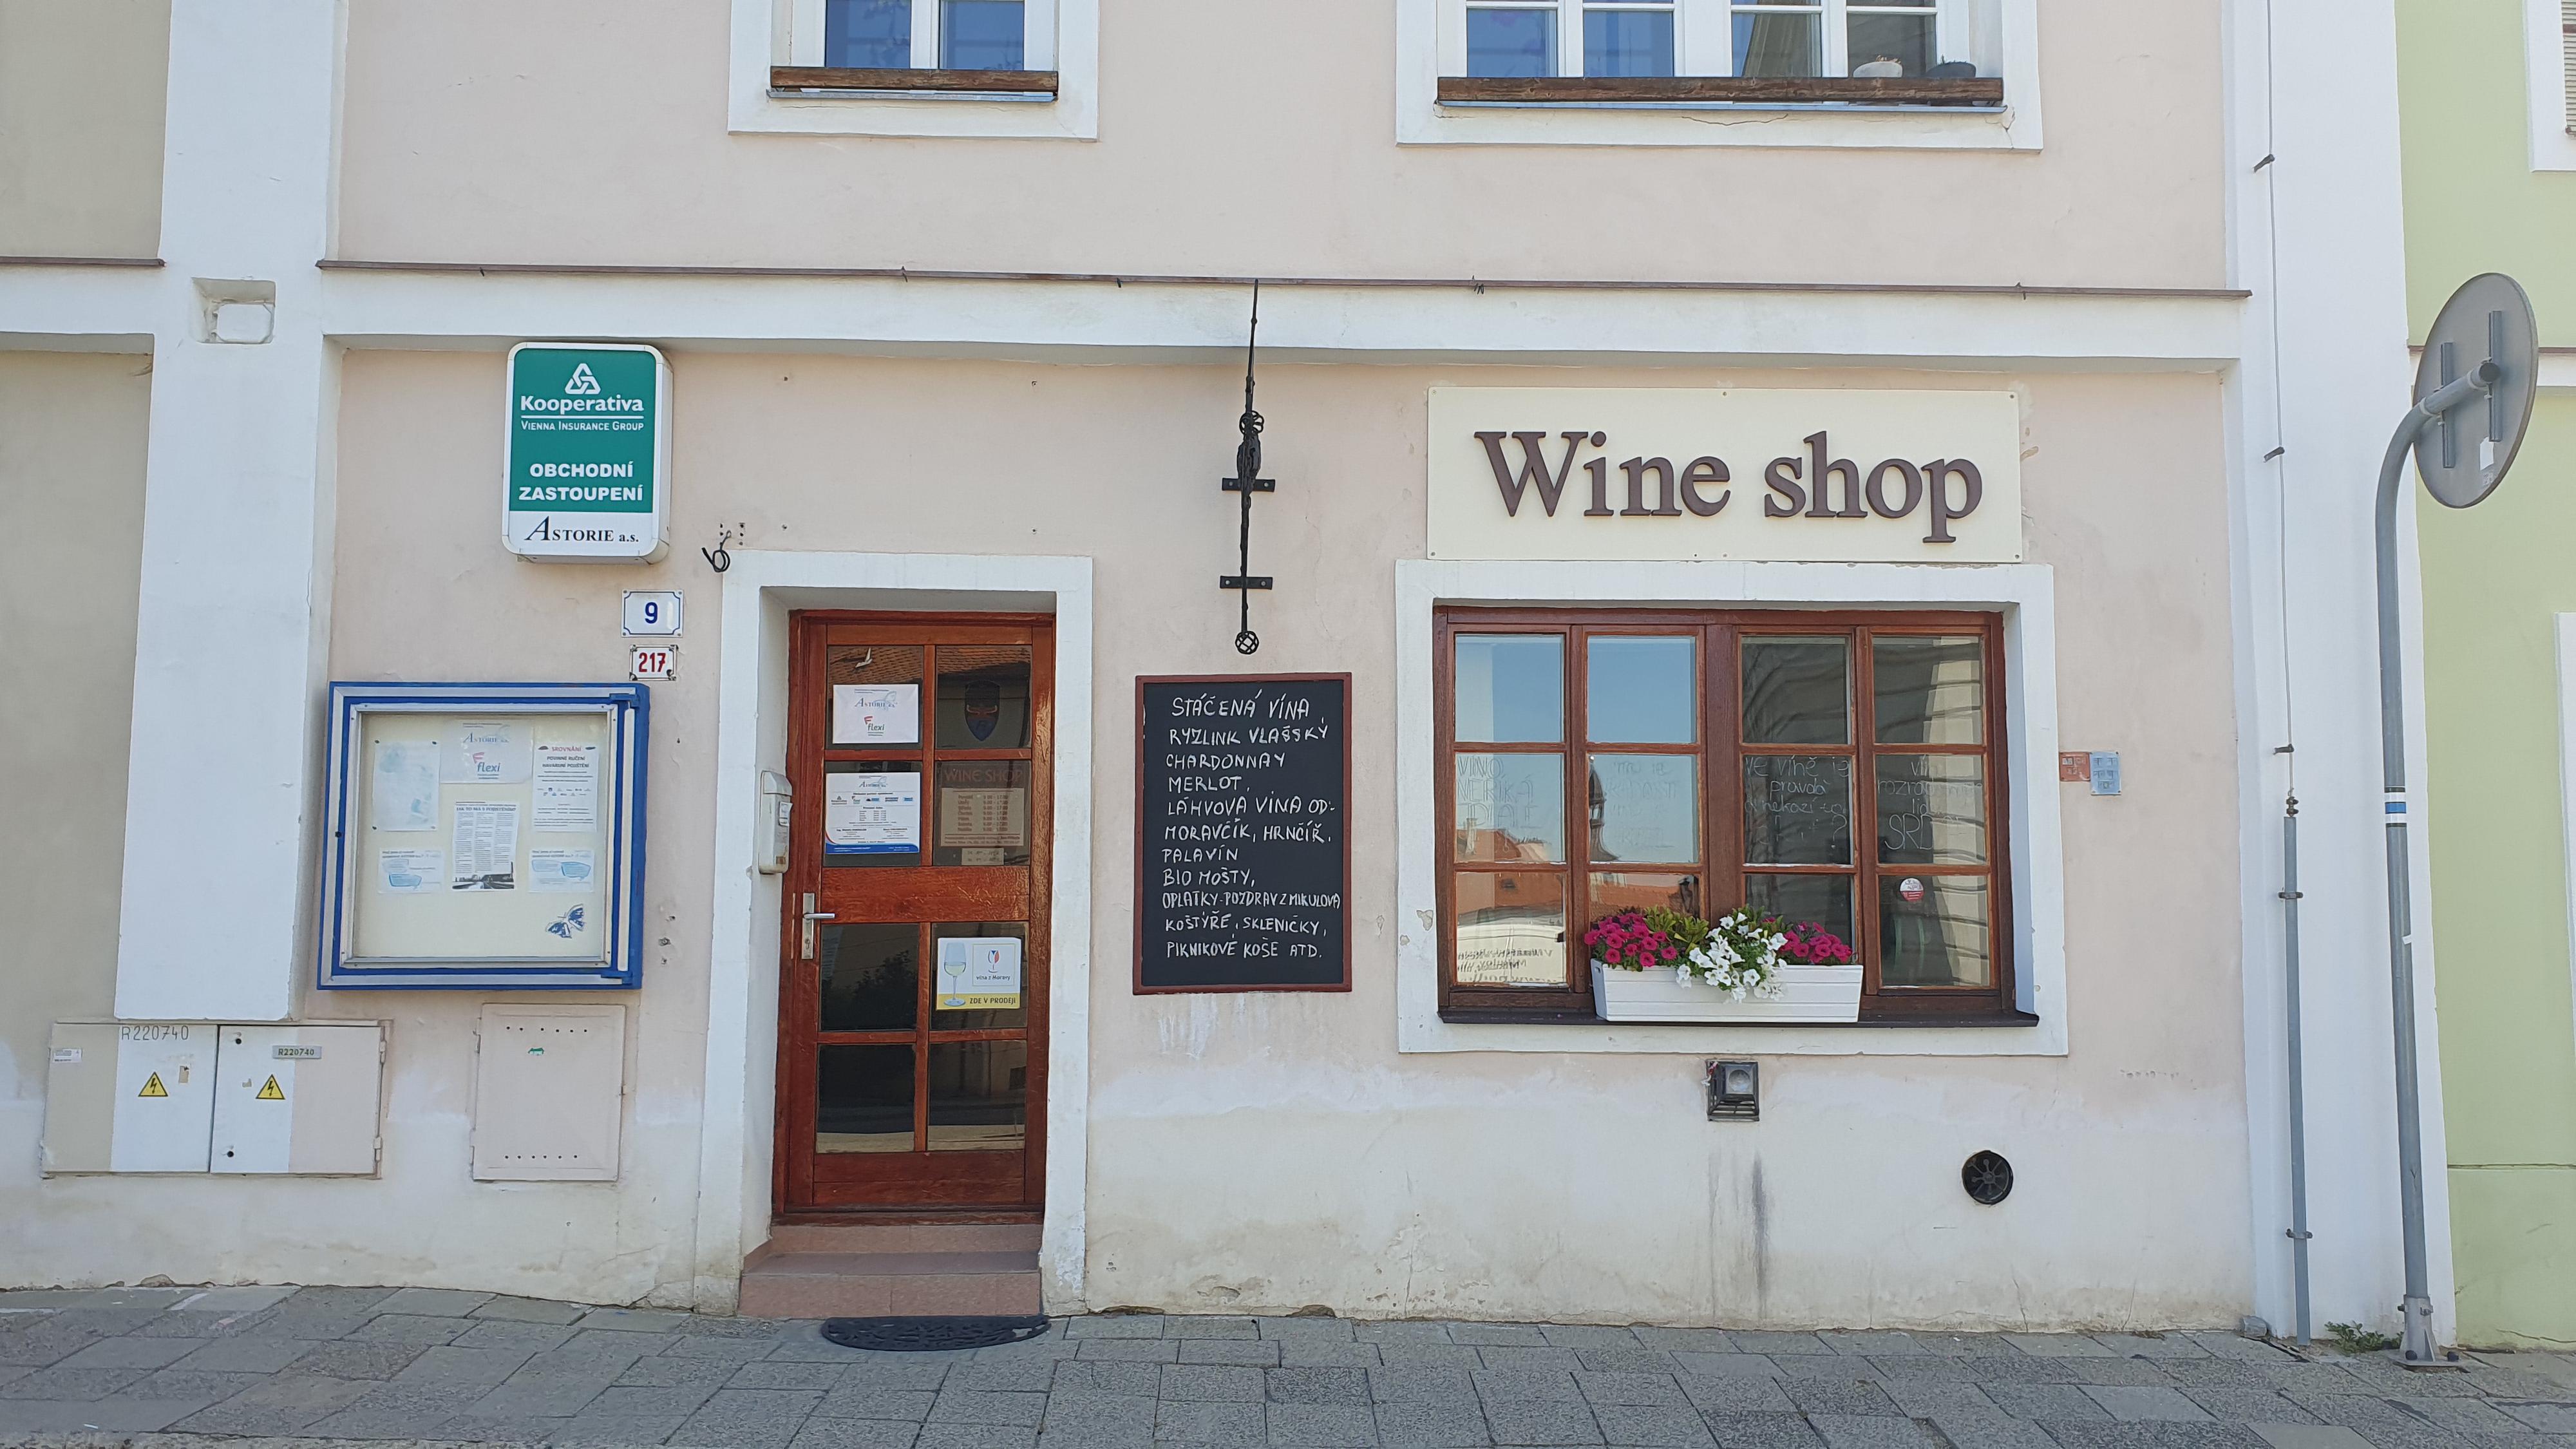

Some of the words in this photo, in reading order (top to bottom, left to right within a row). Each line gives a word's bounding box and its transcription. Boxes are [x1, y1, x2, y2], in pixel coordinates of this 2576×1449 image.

[520, 395, 644, 414] Kooperativa
[521, 421, 555, 431] VIENNA
[558, 421, 609, 431] INSURANCE
[612, 421, 644, 431] GROUP
[530, 461, 634, 477] OBCHODNÍ
[519, 484, 643, 501] ZASTOUPENÍ
[1473, 430, 1731, 518] Wine
[1764, 430, 1983, 544] shop
[524, 516, 614, 542] ASTORIE
[619, 533, 639, 542] a.s.
[645, 601, 658, 624] 9
[638, 652, 667, 673] 217
[1171, 688, 1263, 717] STÁČENÁ
[1269, 693, 1309, 720] VÍNA
[1170, 727, 1240, 745] RYZLINK
[477, 762, 500, 772] flexi
[1166, 752, 1286, 770] CHARDONNAY
[1256, 791, 1302, 814] VÍNA
[1162, 844, 1238, 863] PALAVÍN
[1162, 868, 1191, 886] BIO
[1289, 892, 1341, 909] MIKULOVA
[1244, 936, 1278, 958] KOŠE
[122, 1025, 189, 1041] R220740
